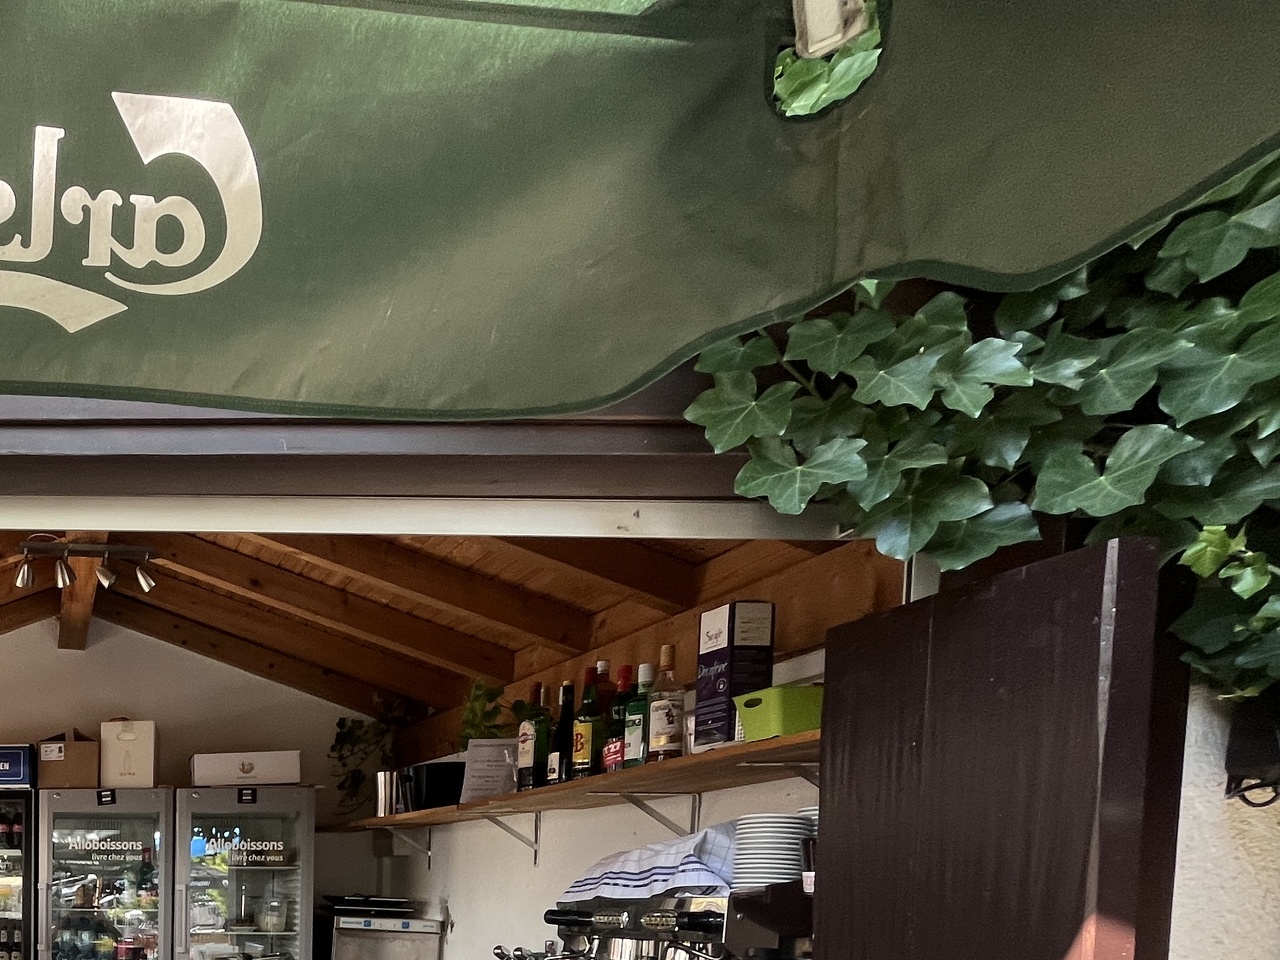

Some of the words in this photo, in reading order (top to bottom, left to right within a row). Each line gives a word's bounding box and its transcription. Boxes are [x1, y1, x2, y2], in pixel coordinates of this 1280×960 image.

[68, 838, 143, 850] Alloboissons
[208, 838, 284, 850] Alloboissons
[91, 853, 107, 861] livre
[108, 853, 125, 861] chez
[248, 853, 265, 861] chez
